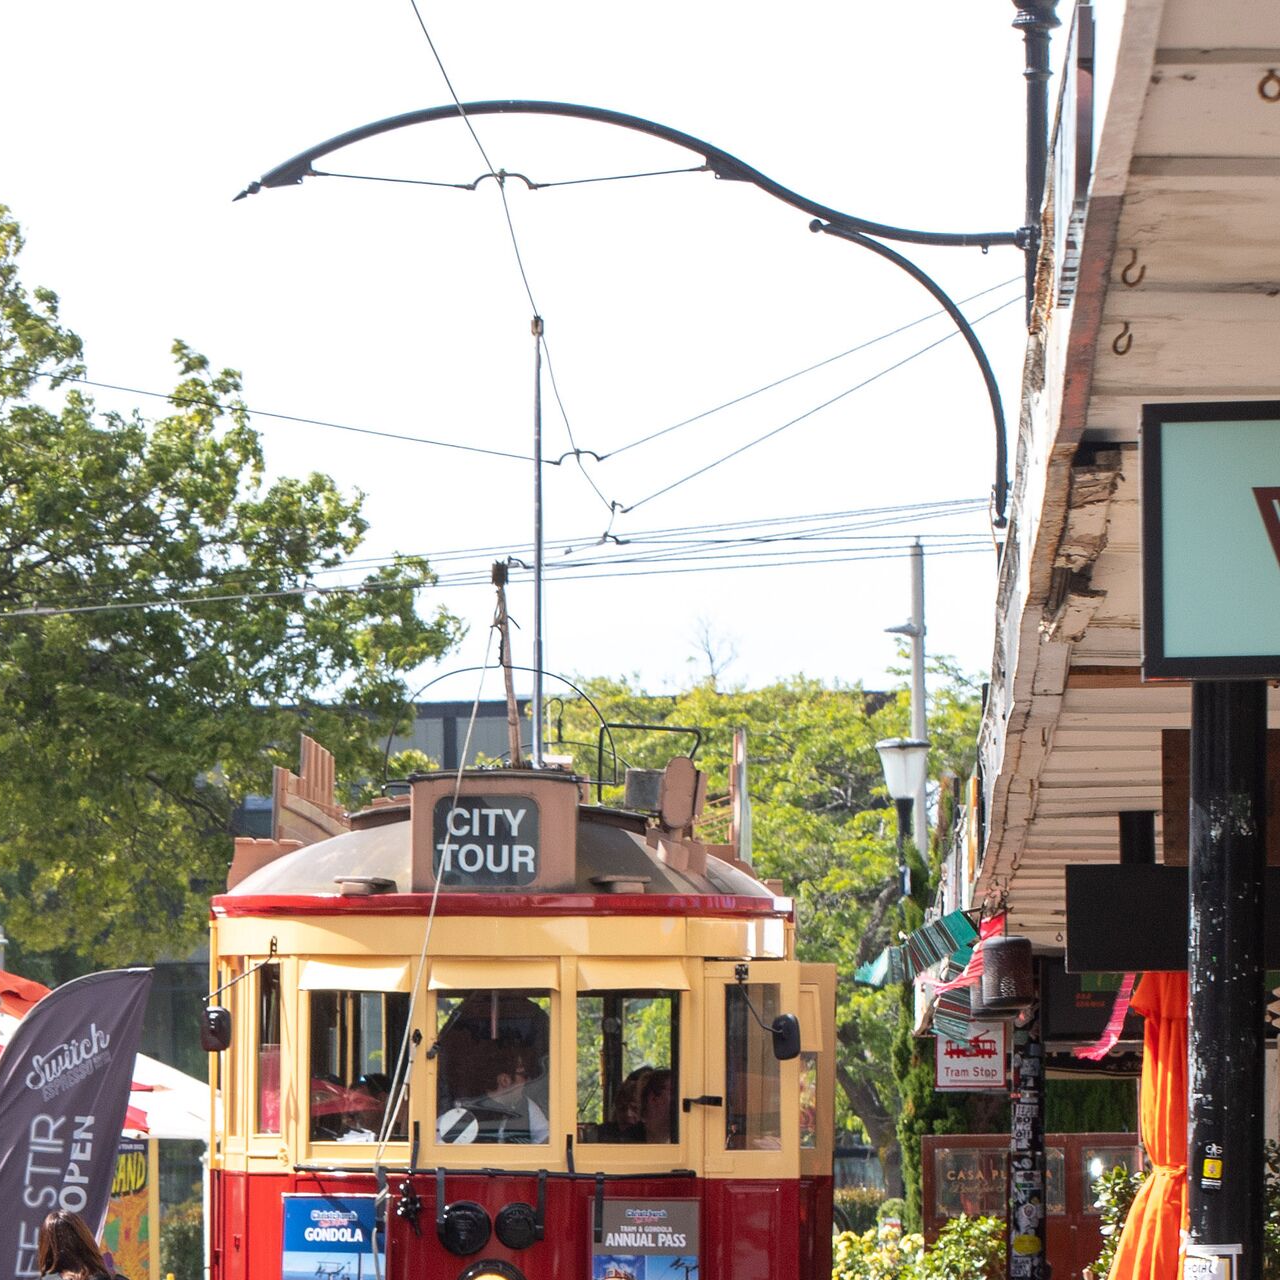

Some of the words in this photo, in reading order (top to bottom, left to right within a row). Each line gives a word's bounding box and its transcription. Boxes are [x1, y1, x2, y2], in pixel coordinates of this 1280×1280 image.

[446, 807, 527, 837] CITY
[436, 843, 536, 873] TOUR
[25, 1022, 111, 1090] Switch
[945, 1066, 969, 1077] Tram
[972, 1066, 998, 1079] Stop
[24, 1113, 67, 1208] STIR
[58, 1115, 95, 1214] OPEN
[946, 1170, 985, 1180] CASA
[304, 1227, 364, 1243] GONDOLA
[605, 1232, 656, 1247] ANNUAL
[657, 1233, 687, 1247] PASS
